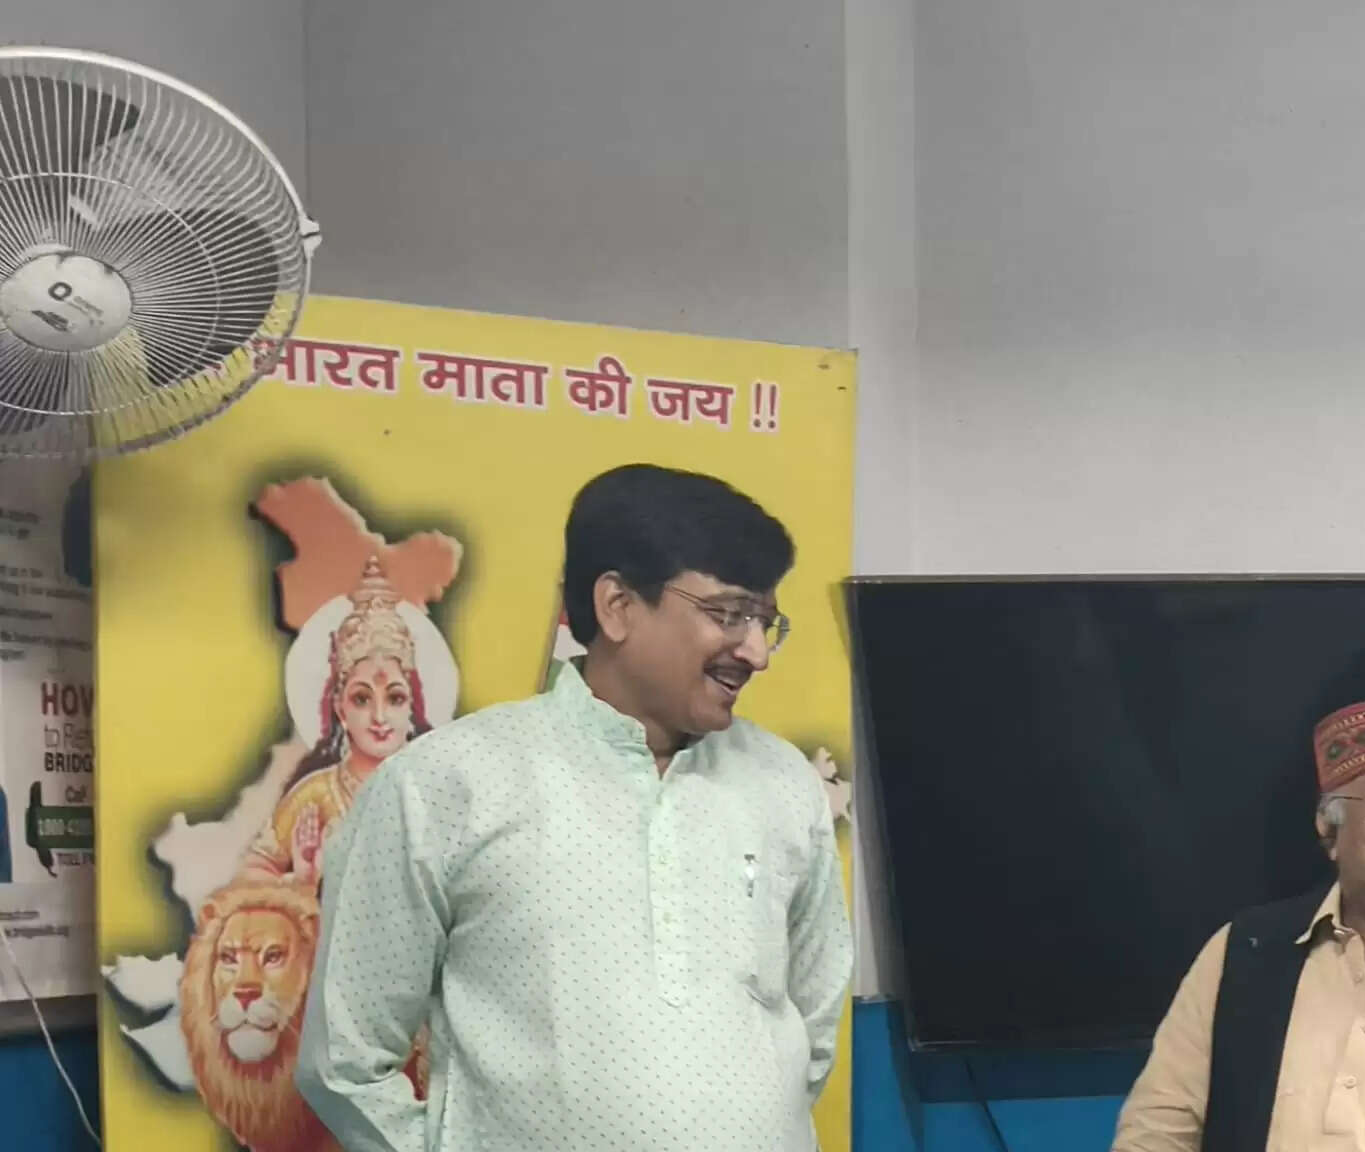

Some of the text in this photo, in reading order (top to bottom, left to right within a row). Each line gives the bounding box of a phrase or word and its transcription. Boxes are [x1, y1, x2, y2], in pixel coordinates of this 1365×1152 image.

[417, 353, 548, 407] माता
[566, 357, 632, 414] की
[648, 379, 734, 426] जय
[753, 382, 777, 429] !!
